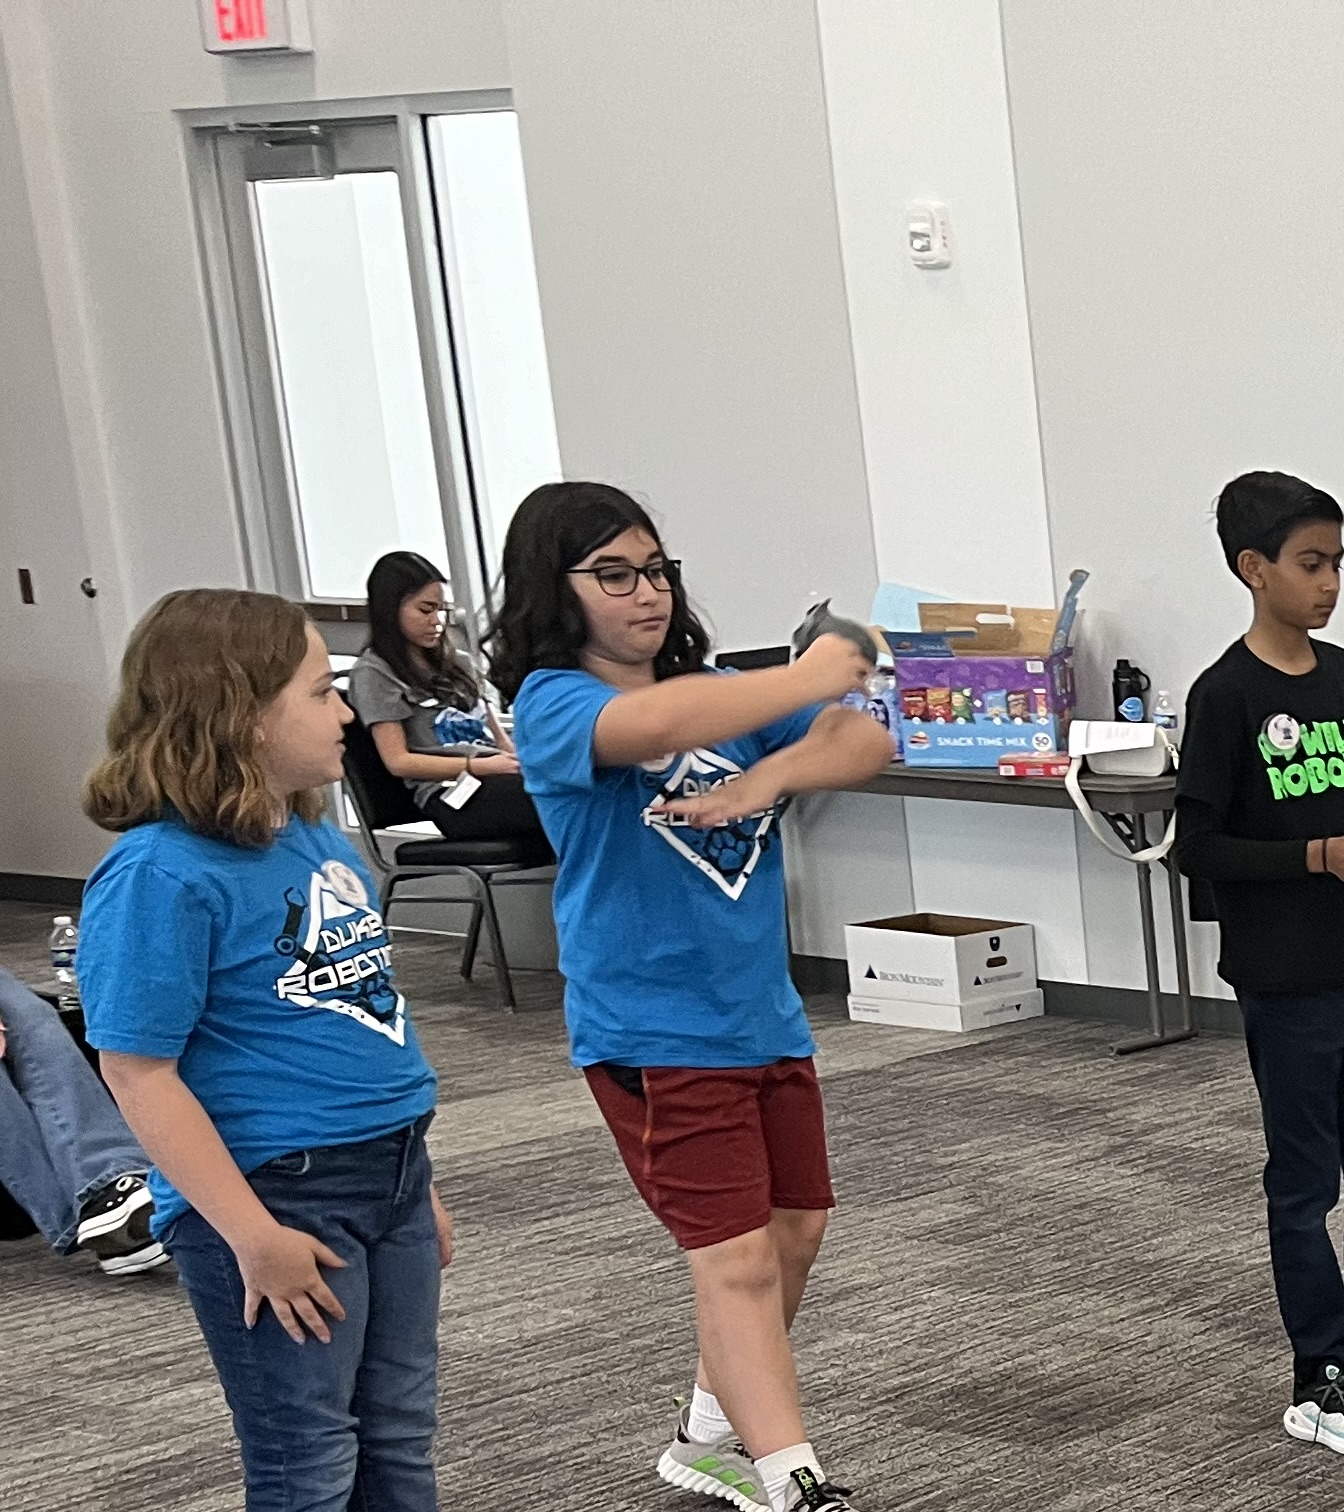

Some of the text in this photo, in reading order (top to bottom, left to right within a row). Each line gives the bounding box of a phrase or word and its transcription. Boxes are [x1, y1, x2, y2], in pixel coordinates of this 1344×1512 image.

[215, 0, 267, 40] EXIT
[936, 737, 974, 747] SNACK
[977, 737, 1004, 747] TIME
[1006, 737, 1028, 747] MIX
